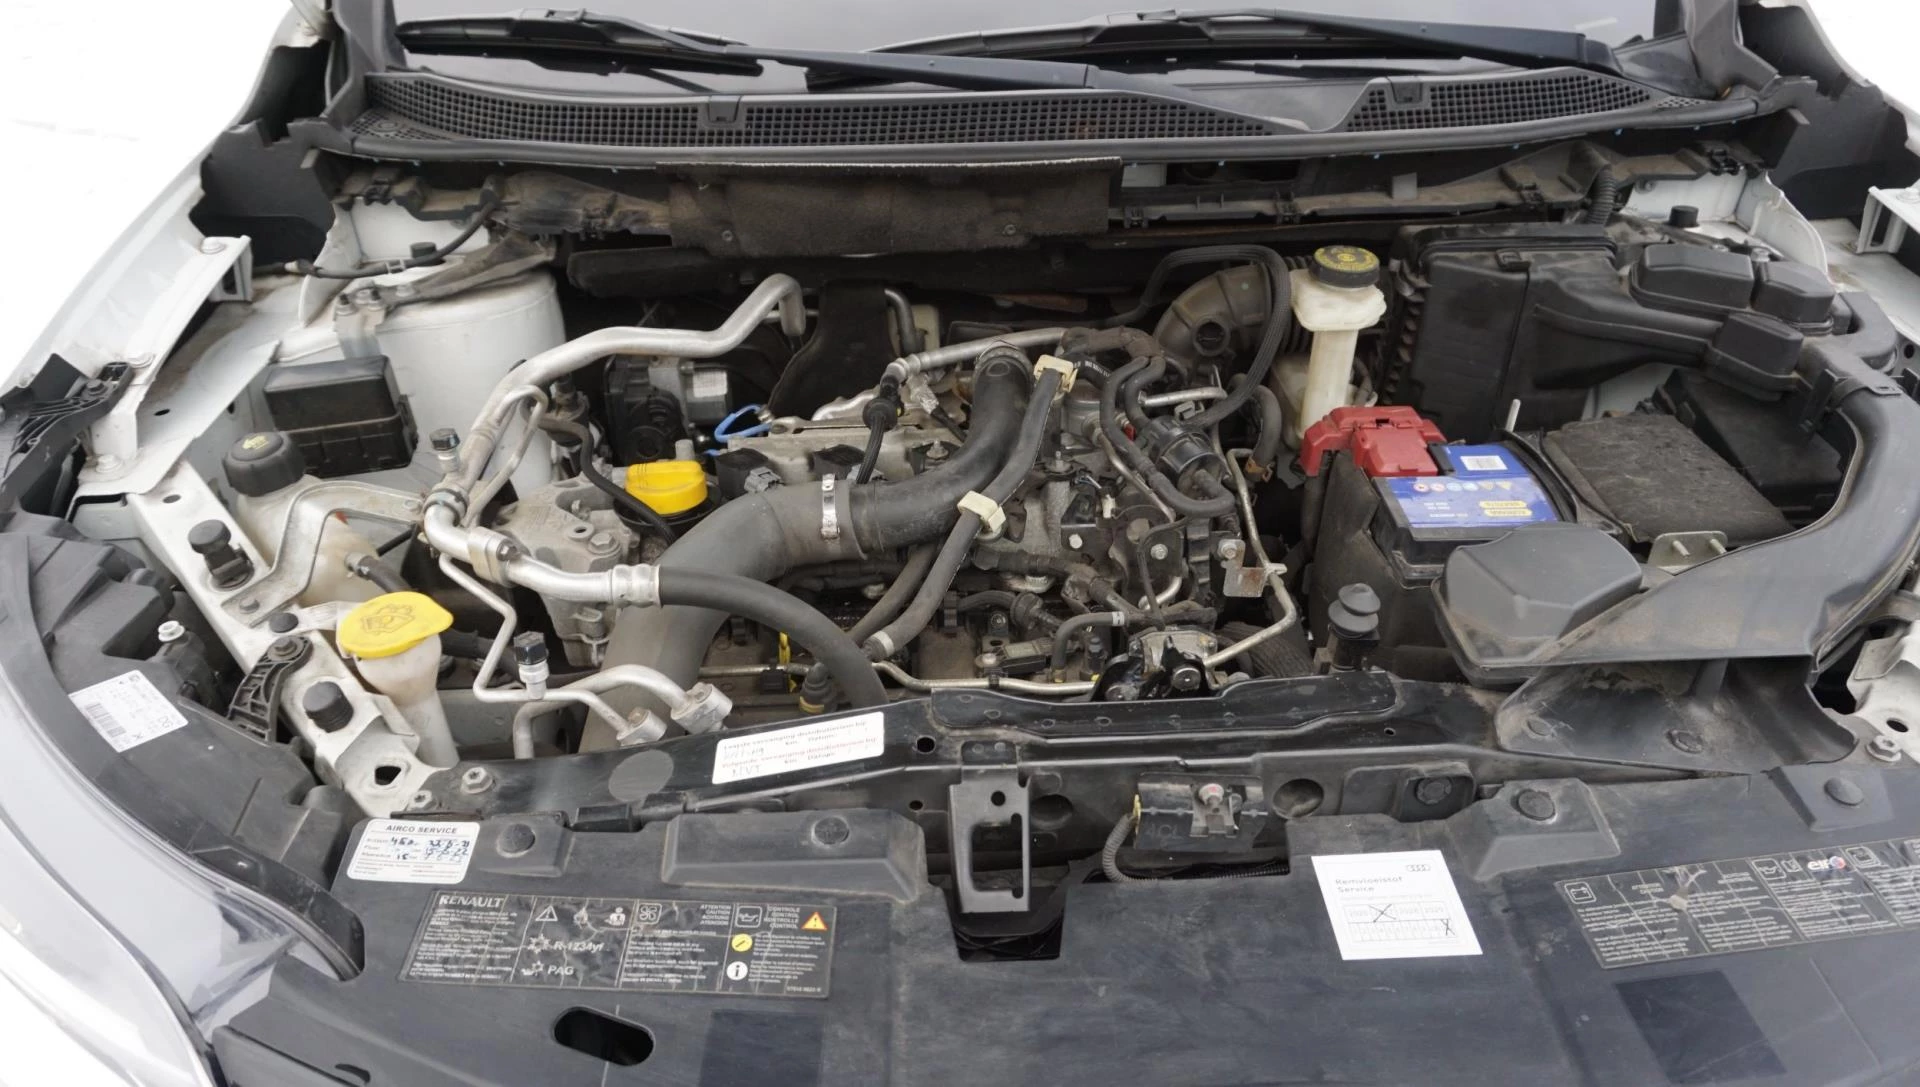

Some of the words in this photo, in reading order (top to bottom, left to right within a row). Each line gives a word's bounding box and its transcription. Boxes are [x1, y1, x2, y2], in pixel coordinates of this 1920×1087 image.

[386, 825, 415, 833] AIRCO
[418, 825, 458, 834] SERVICE
[439, 895, 505, 908] RENAULT
[553, 941, 605, 953] R-1234yf
[547, 965, 574, 976] PAG
